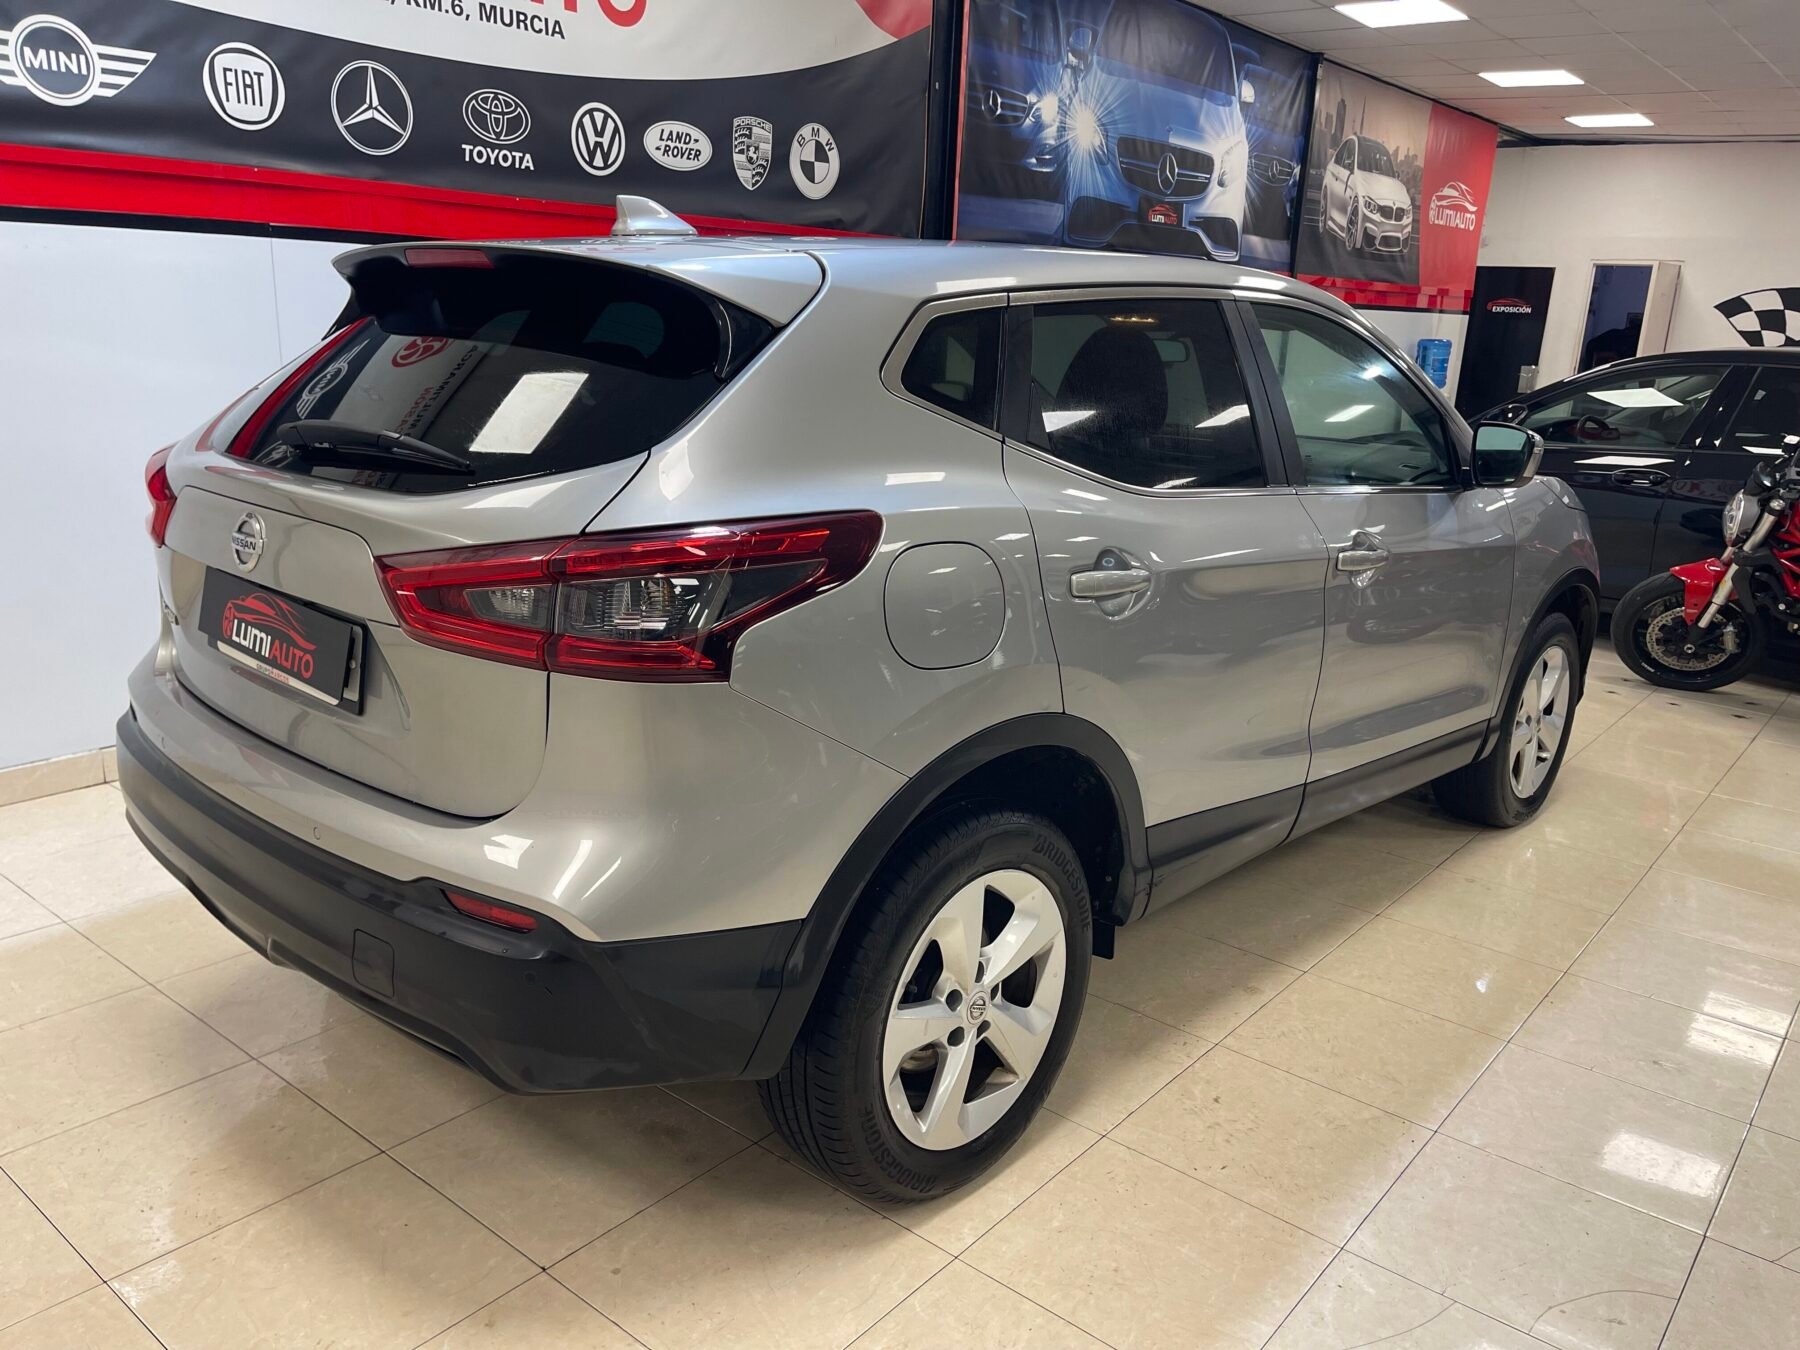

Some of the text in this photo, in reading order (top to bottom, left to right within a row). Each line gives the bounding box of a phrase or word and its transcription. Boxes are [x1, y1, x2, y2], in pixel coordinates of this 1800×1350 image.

[478, 2, 566, 39] MURCIA
[22, 46, 88, 76] MINI
[222, 66, 264, 107] FIAT
[658, 128, 694, 145] LAND
[735, 117, 771, 133] PORSCHE
[461, 144, 535, 170] TOYOTA
[661, 144, 702, 162] ROVER
[1434, 207, 1476, 231] LUMIAUTO
[1492, 305, 1532, 313] EXPOSICIÓN
[232, 618, 314, 679] LUMIAUTO
[1032, 834, 1091, 933] BRIDGESTONE
